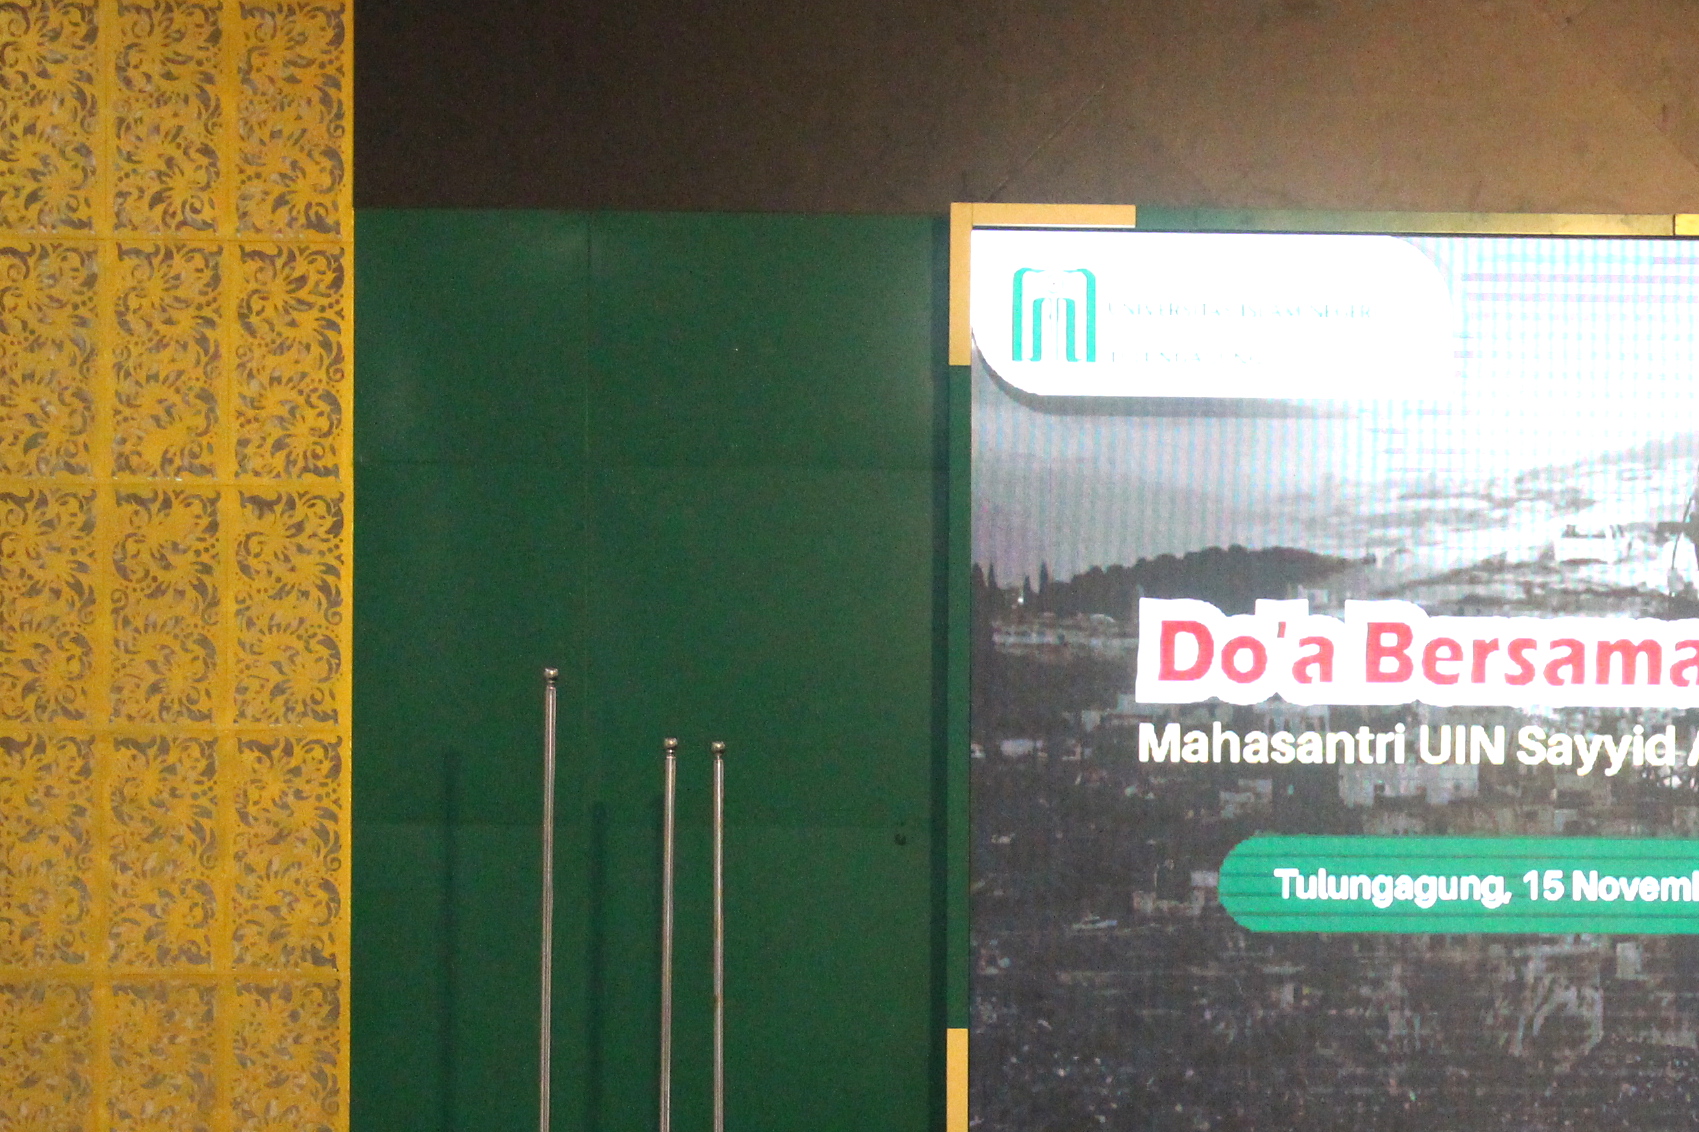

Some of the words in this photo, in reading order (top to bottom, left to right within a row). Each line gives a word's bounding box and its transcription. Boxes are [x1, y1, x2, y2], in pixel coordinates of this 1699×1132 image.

[1159, 620, 1335, 684] Do'a
[1138, 721, 1406, 765] Mahasantri
[1419, 724, 1505, 766] UIN
[1516, 725, 1677, 776] Sayyid
[1273, 867, 1513, 909] Tulungagung,
[1522, 869, 1565, 902] 15
